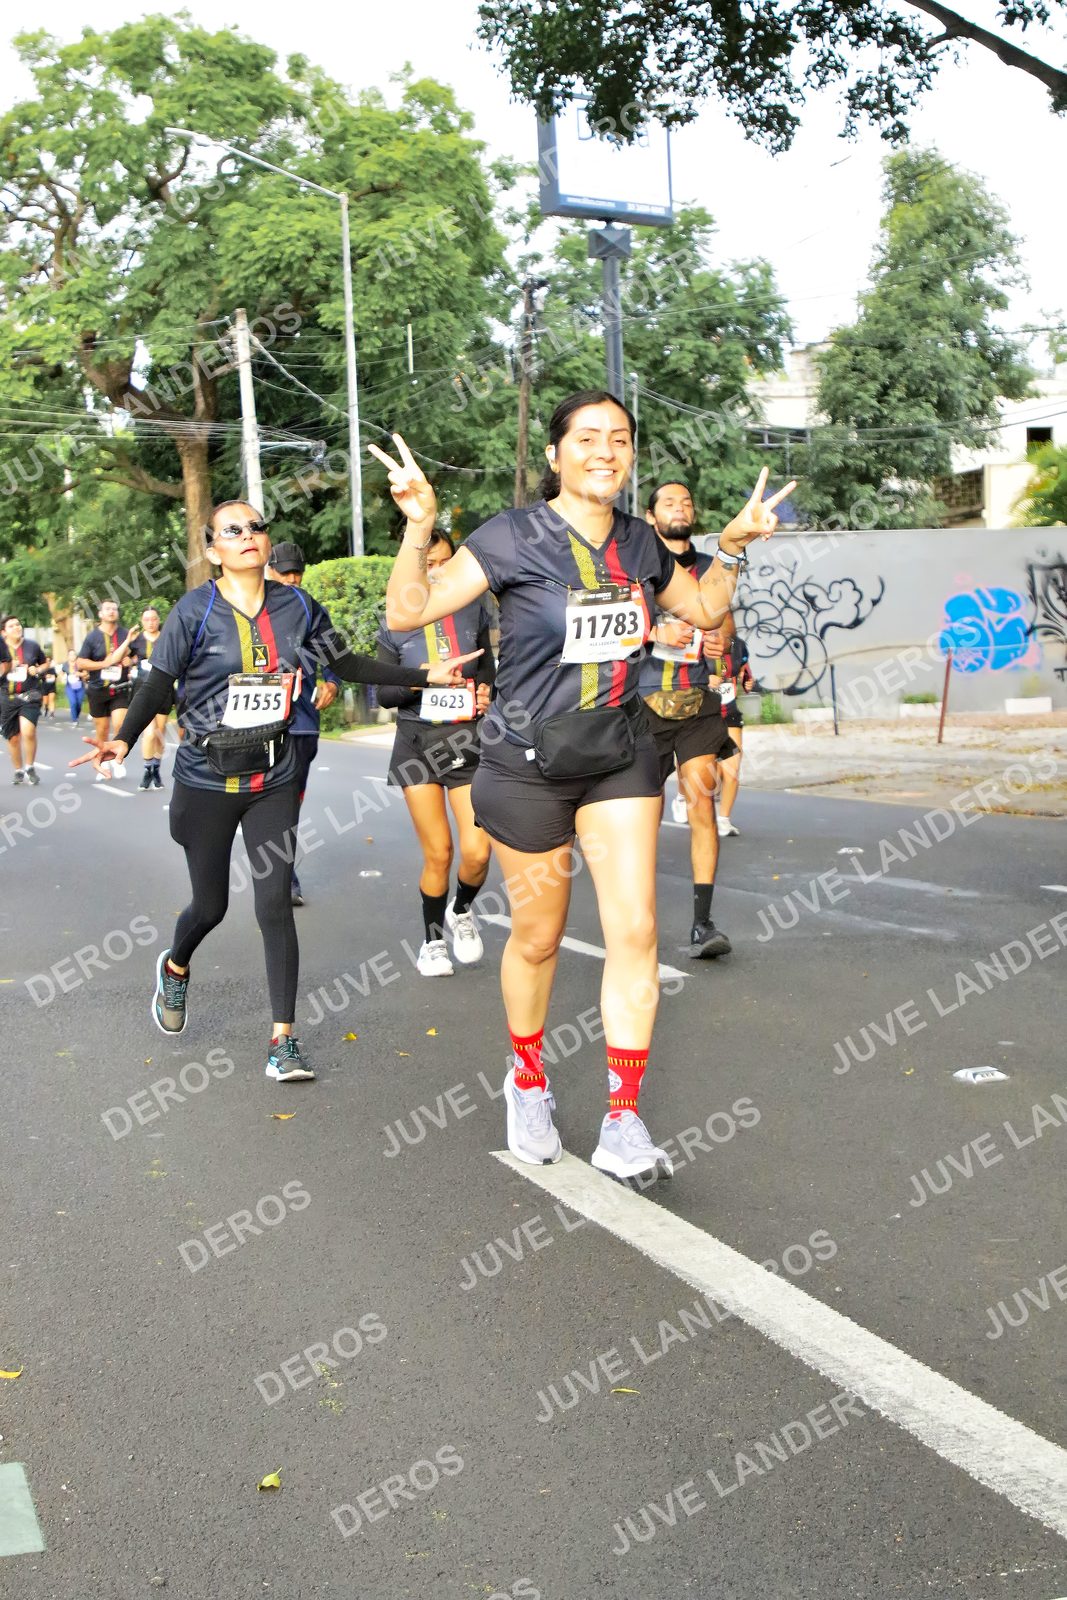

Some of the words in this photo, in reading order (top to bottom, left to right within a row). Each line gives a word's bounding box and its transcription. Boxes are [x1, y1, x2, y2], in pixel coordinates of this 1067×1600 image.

[572, 610, 639, 640] 11783
[232, 693, 282, 711] 11555
[430, 694, 465, 709] 9623
